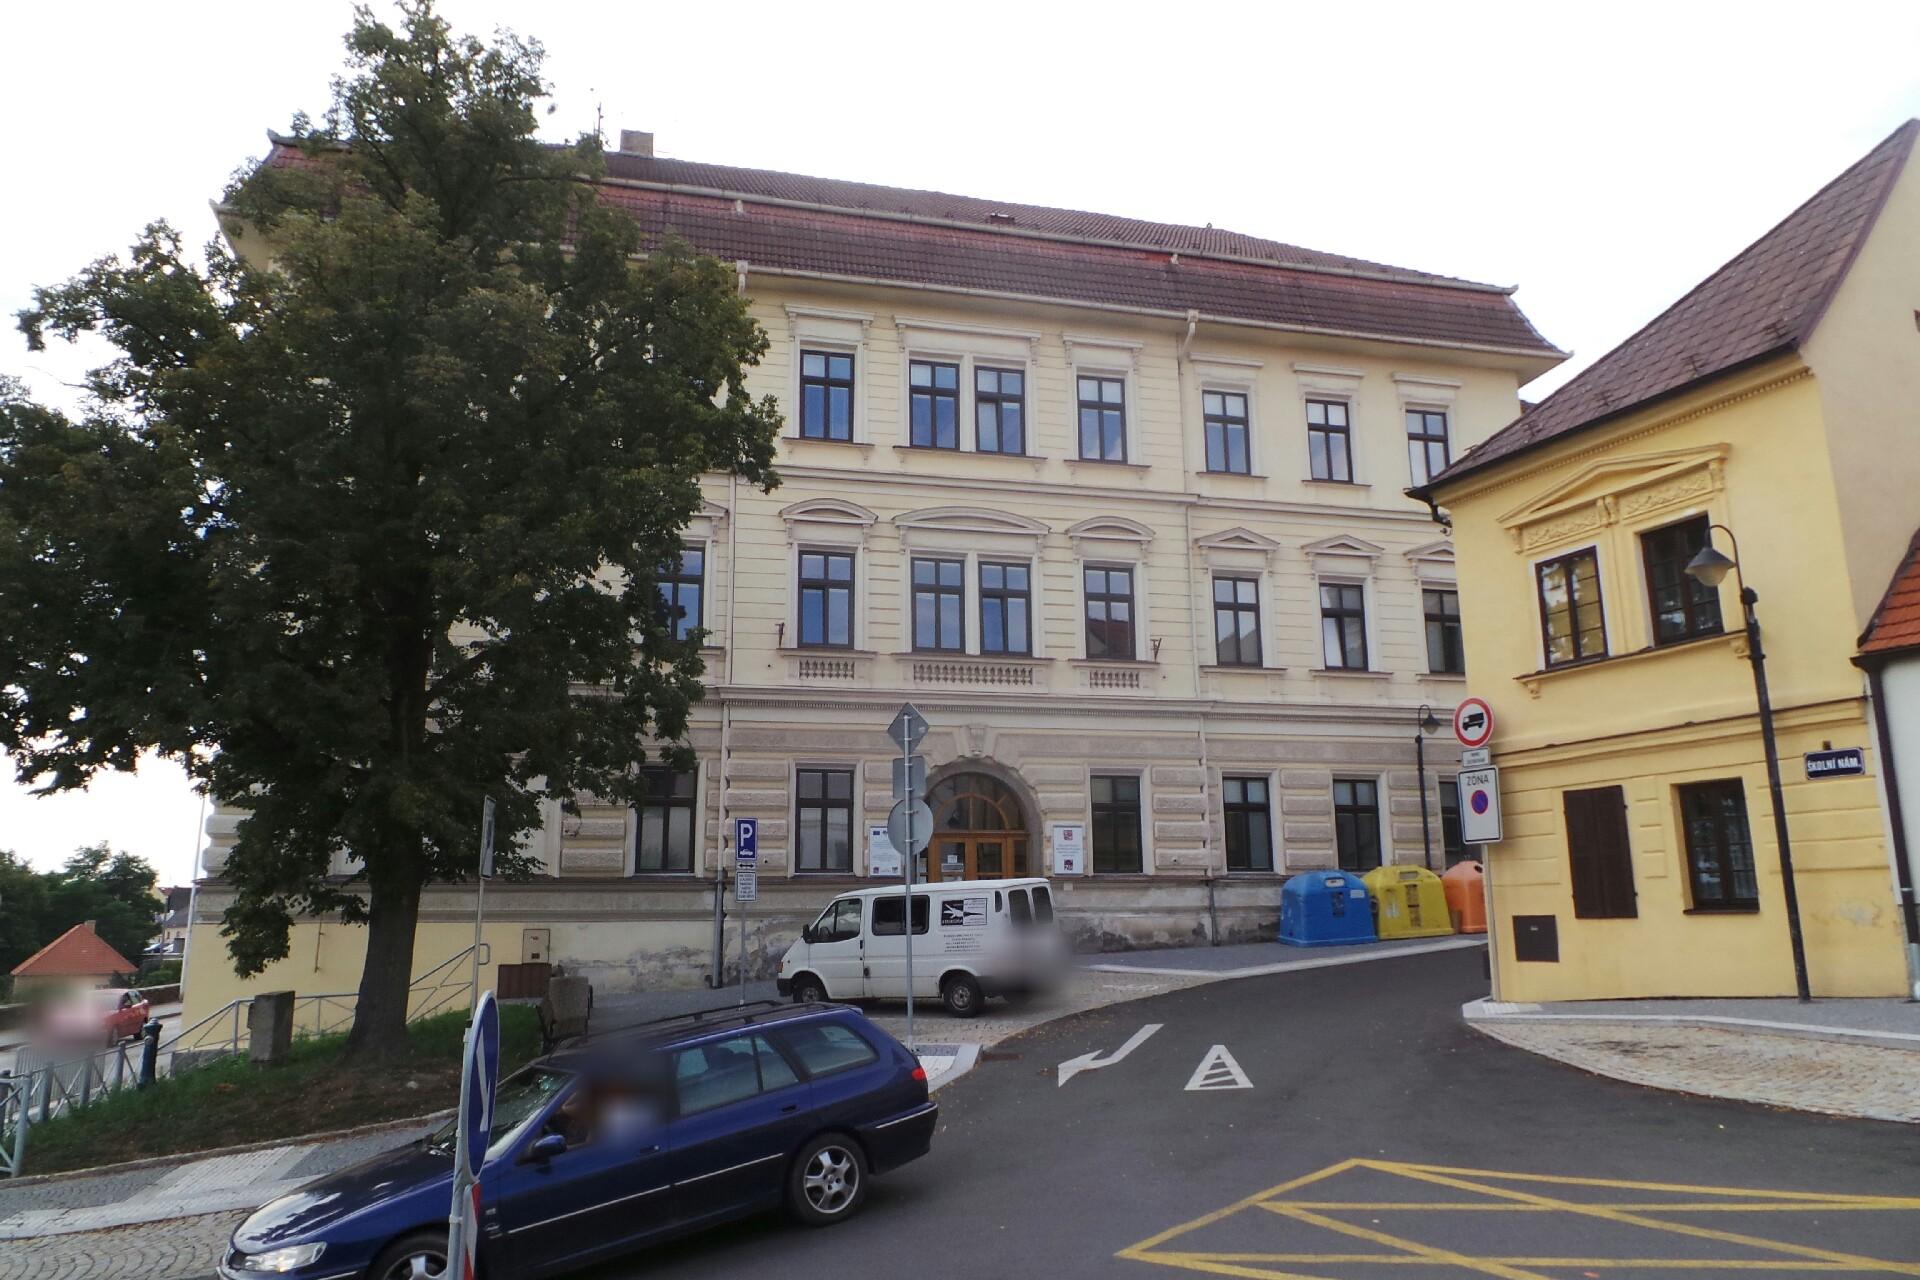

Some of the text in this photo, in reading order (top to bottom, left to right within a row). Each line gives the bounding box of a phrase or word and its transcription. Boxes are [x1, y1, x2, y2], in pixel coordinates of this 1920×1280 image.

[1807, 756, 1862, 771] ŠKOLNÍ NÁM.
[740, 823, 753, 847] P
